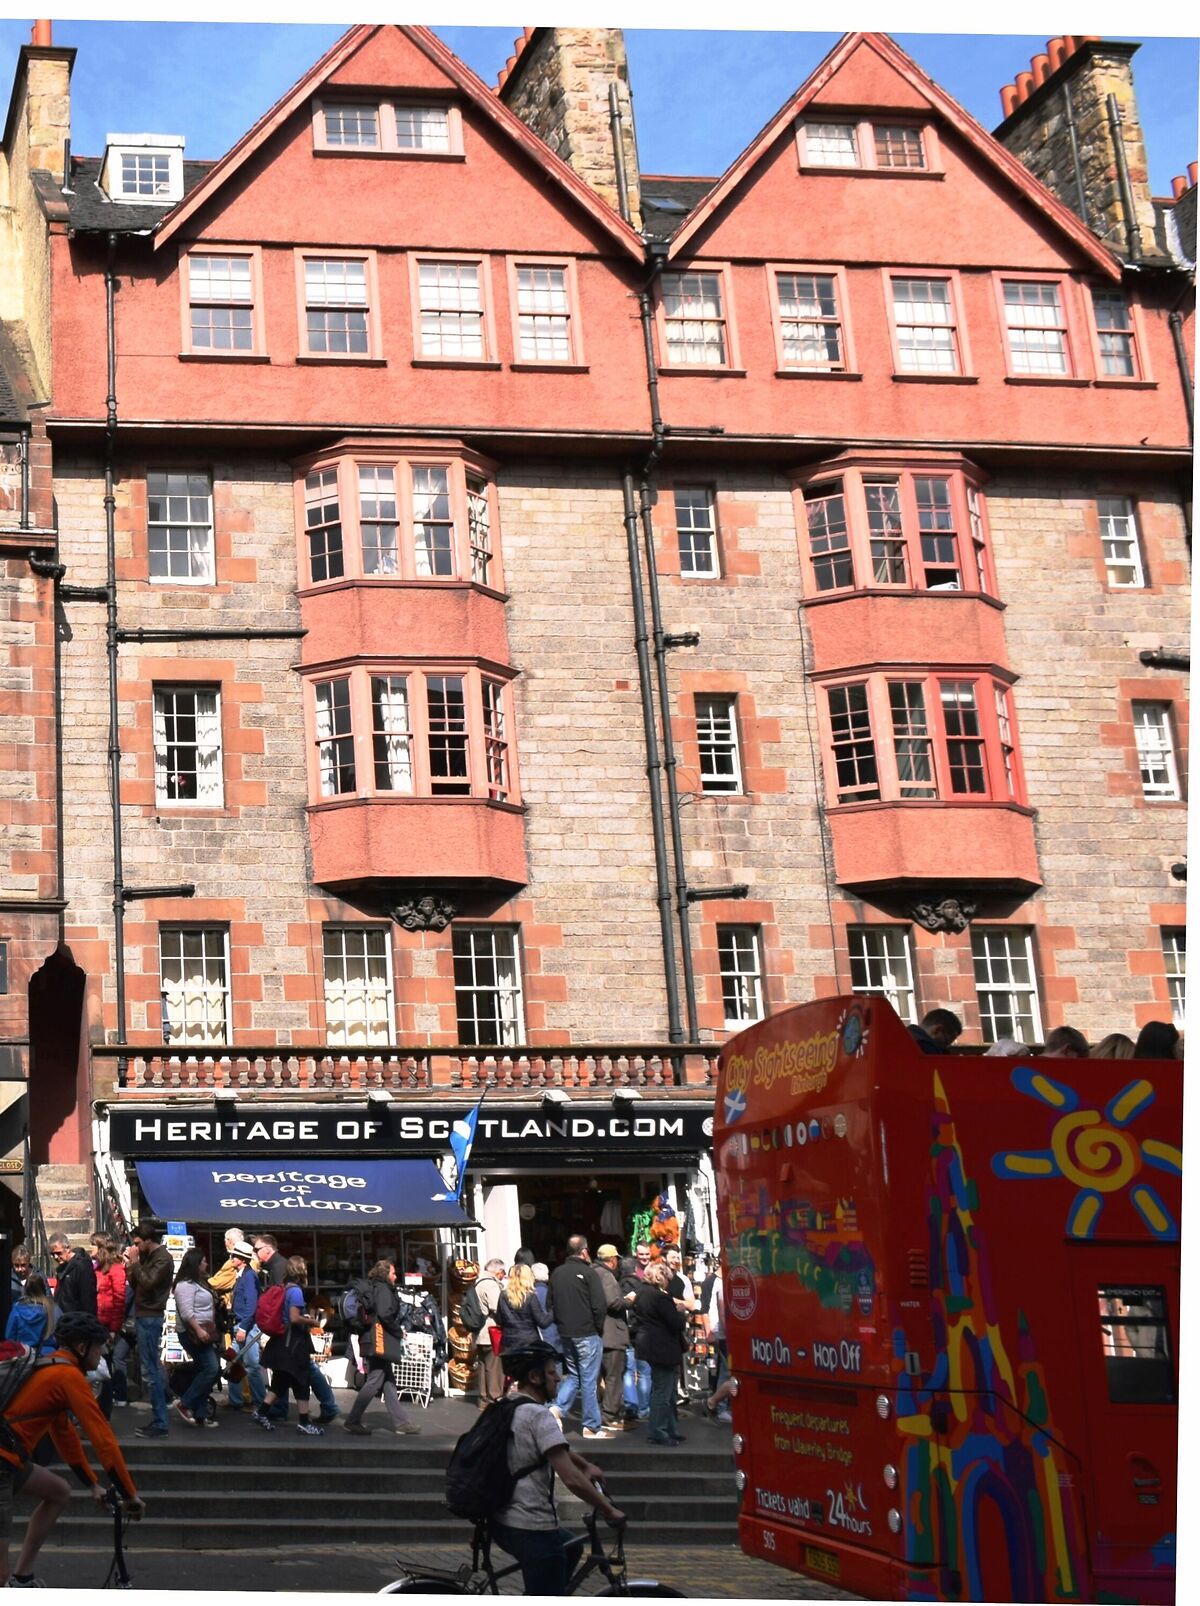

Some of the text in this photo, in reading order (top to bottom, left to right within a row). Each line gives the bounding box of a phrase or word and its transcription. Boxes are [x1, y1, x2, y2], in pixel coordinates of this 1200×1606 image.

[725, 1030, 840, 1094] City Sightseeing
[135, 1118, 319, 1141] HERITAGE
[211, 1170, 367, 1189] heritage
[279, 1184, 312, 1195] of
[219, 1195, 383, 1214] scotland
[751, 1338, 772, 1365] Hop
[774, 1336, 791, 1364] On
[813, 1343, 838, 1373] Hop
[839, 1340, 861, 1371] Off
[755, 1487, 786, 1513] Tickets
[787, 1496, 810, 1519] valid
[826, 1489, 847, 1528] 24
[845, 1514, 872, 1536] hours
